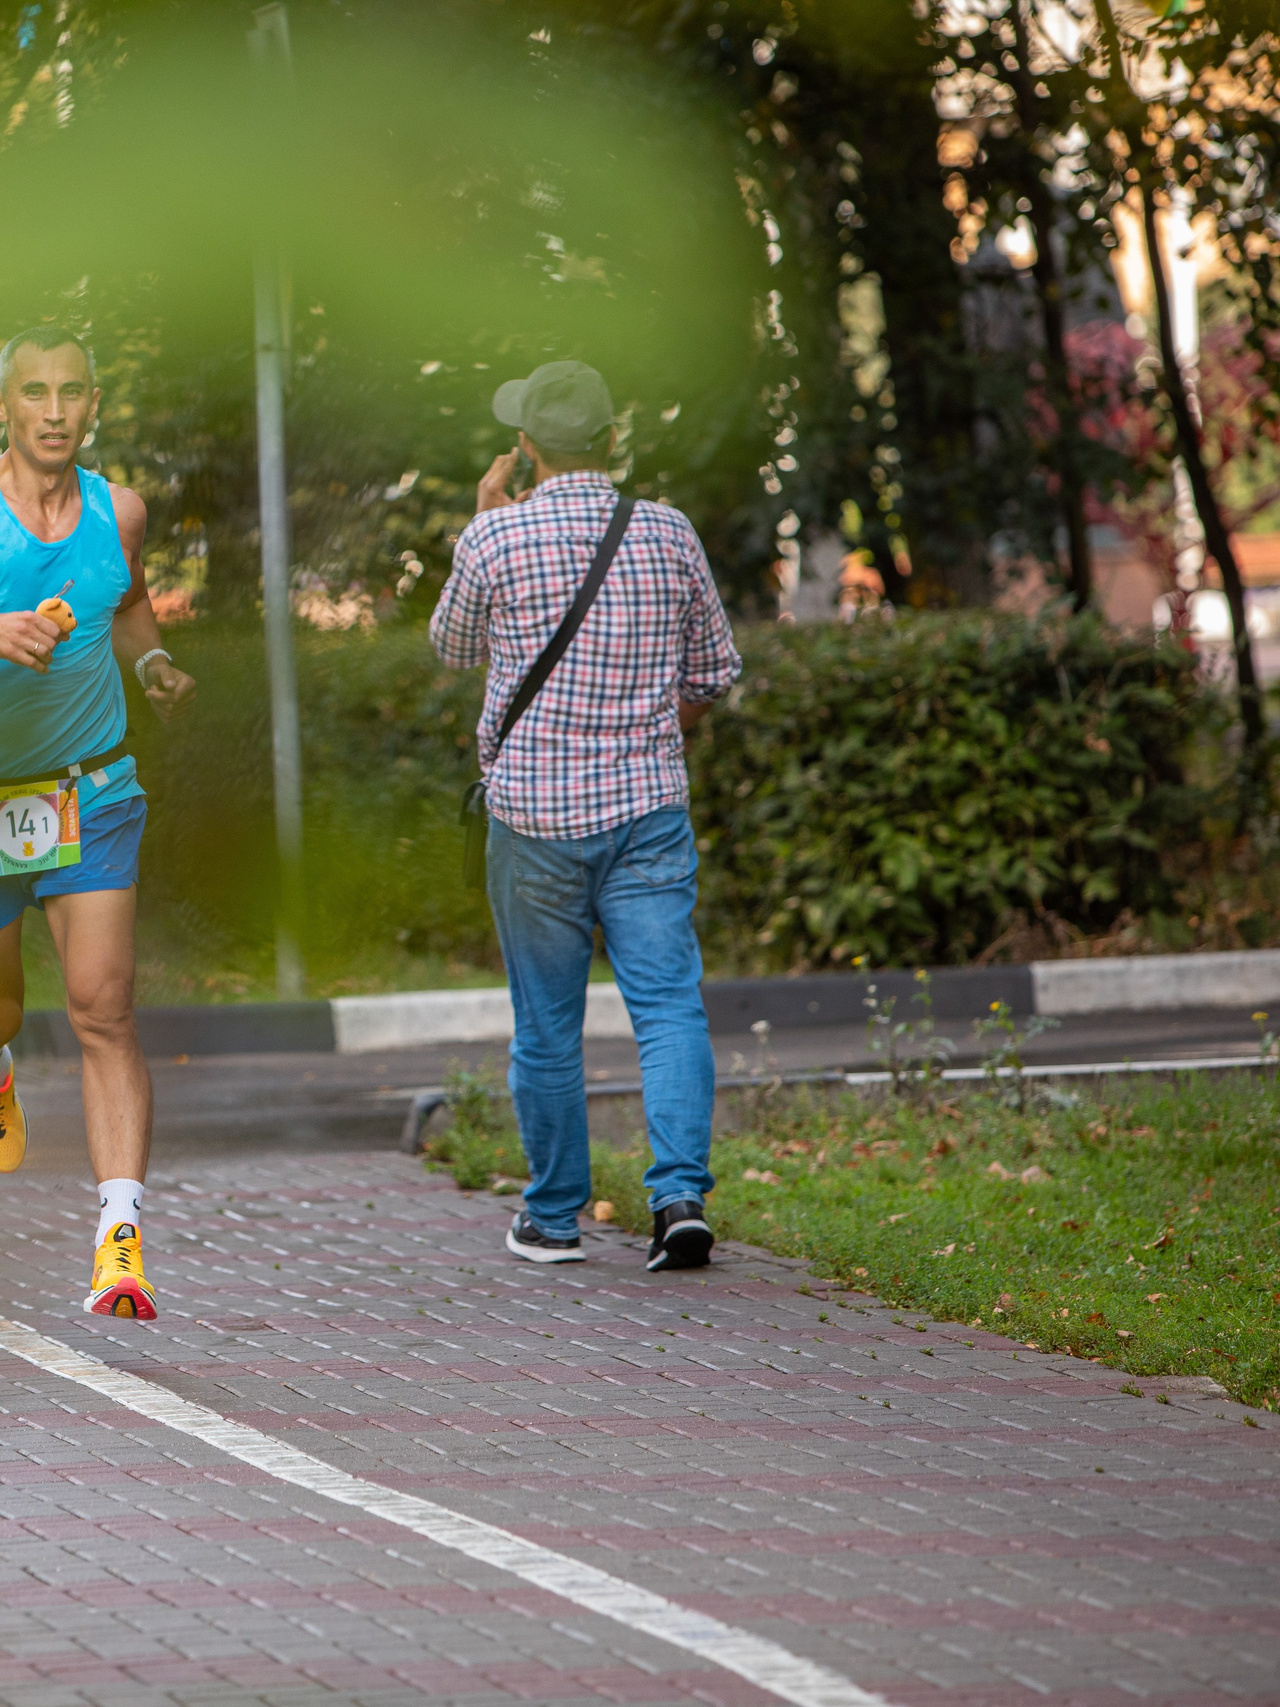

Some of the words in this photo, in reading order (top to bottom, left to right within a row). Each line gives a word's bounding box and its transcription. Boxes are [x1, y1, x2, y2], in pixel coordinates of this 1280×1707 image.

[5, 808, 36, 838] 14
[41, 816, 49, 834] 1
[68, 798, 77, 838] ЭСТАФЕТА
[3, 856, 28, 869] KANNAS
